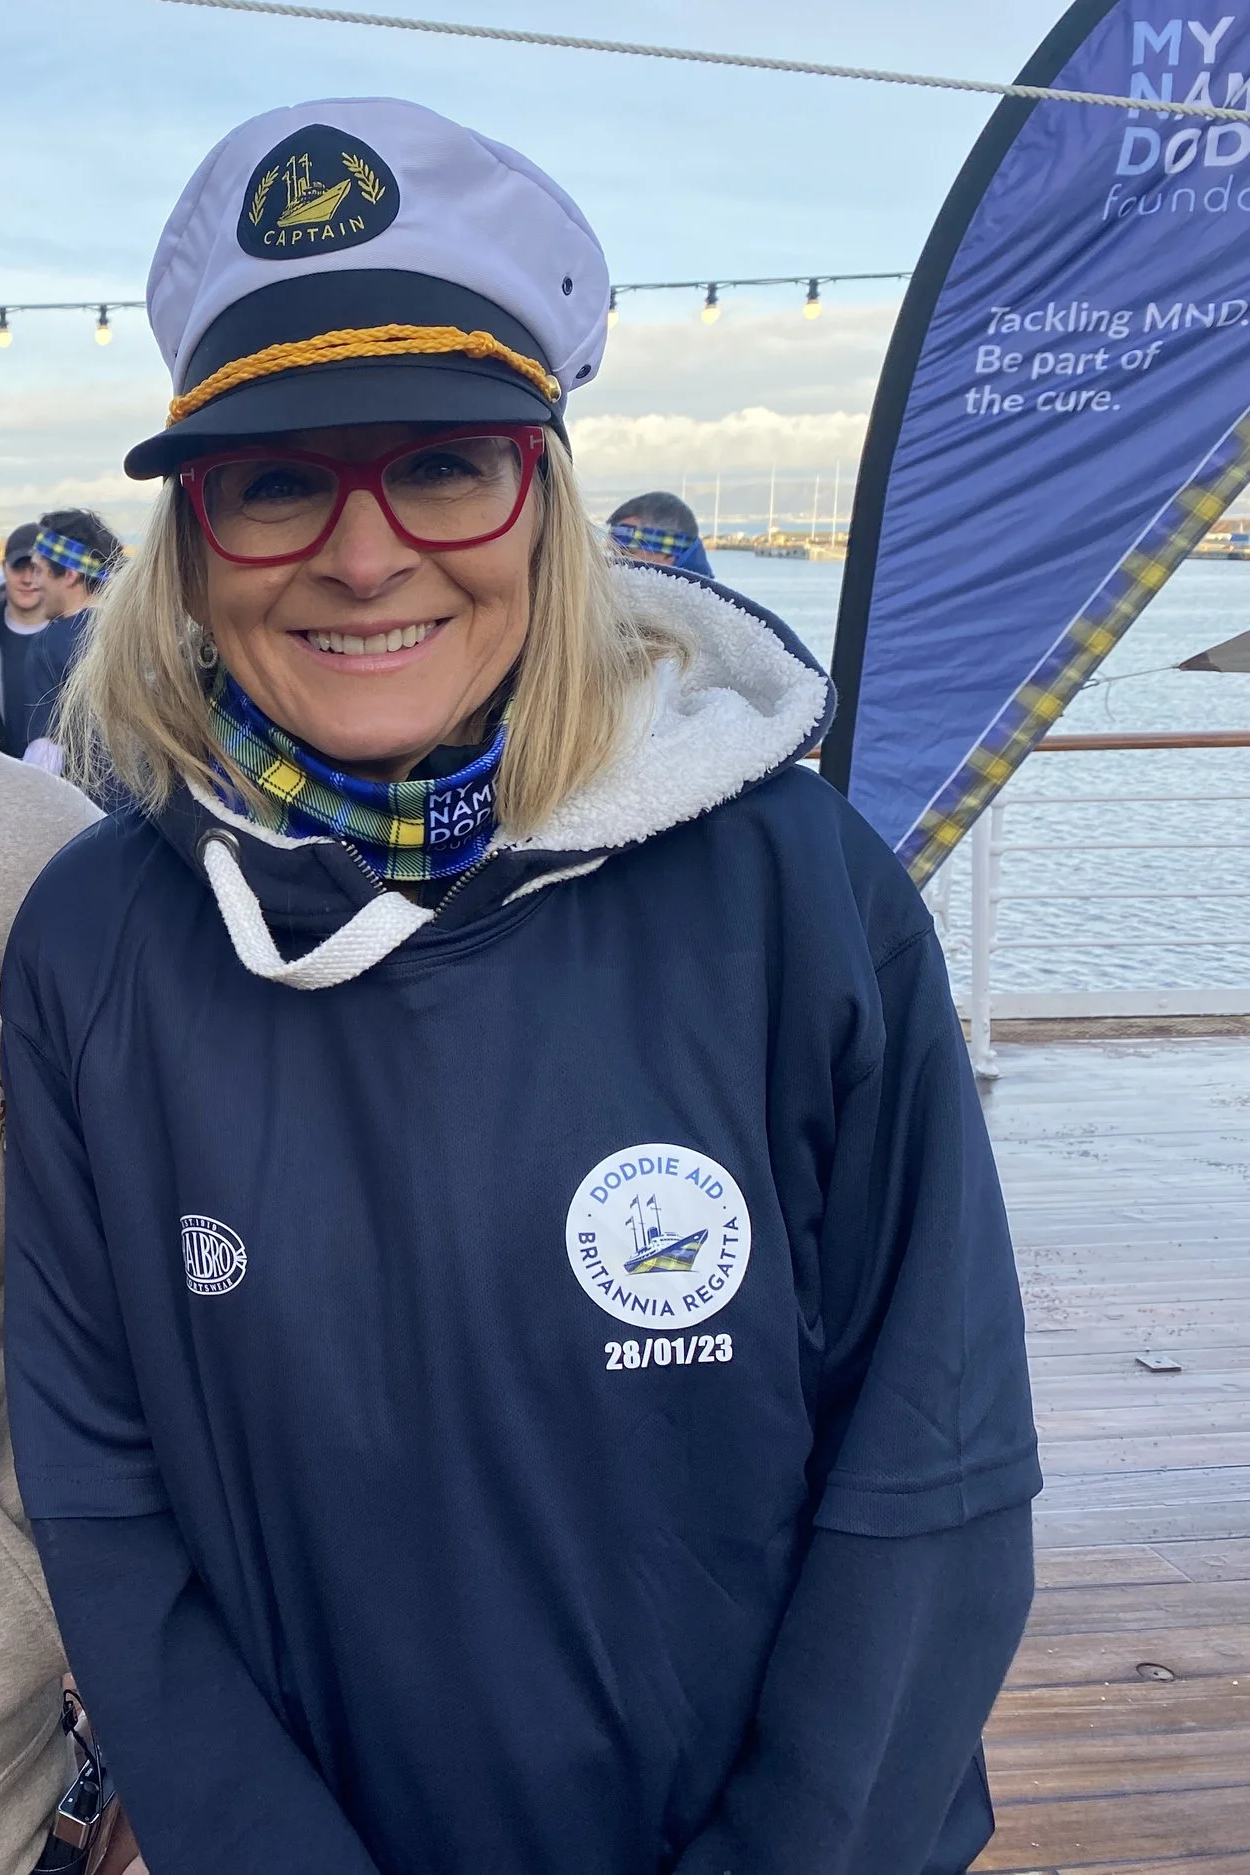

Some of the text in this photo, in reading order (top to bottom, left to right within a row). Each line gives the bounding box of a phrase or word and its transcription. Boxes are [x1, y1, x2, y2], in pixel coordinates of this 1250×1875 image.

[1132, 16, 1236, 66] MY
[264, 216, 365, 246] CAPTAIN
[987, 299, 1249, 340] Tackling MND.
[975, 340, 1163, 380] Be part of
[965, 385, 1121, 415] the cure.
[430, 782, 474, 808] MY
[590, 1157, 723, 1205] DODDIE AID
[578, 1216, 739, 1316] BRITANNIA REGATTA
[605, 1333, 733, 1370] 28/01/23
